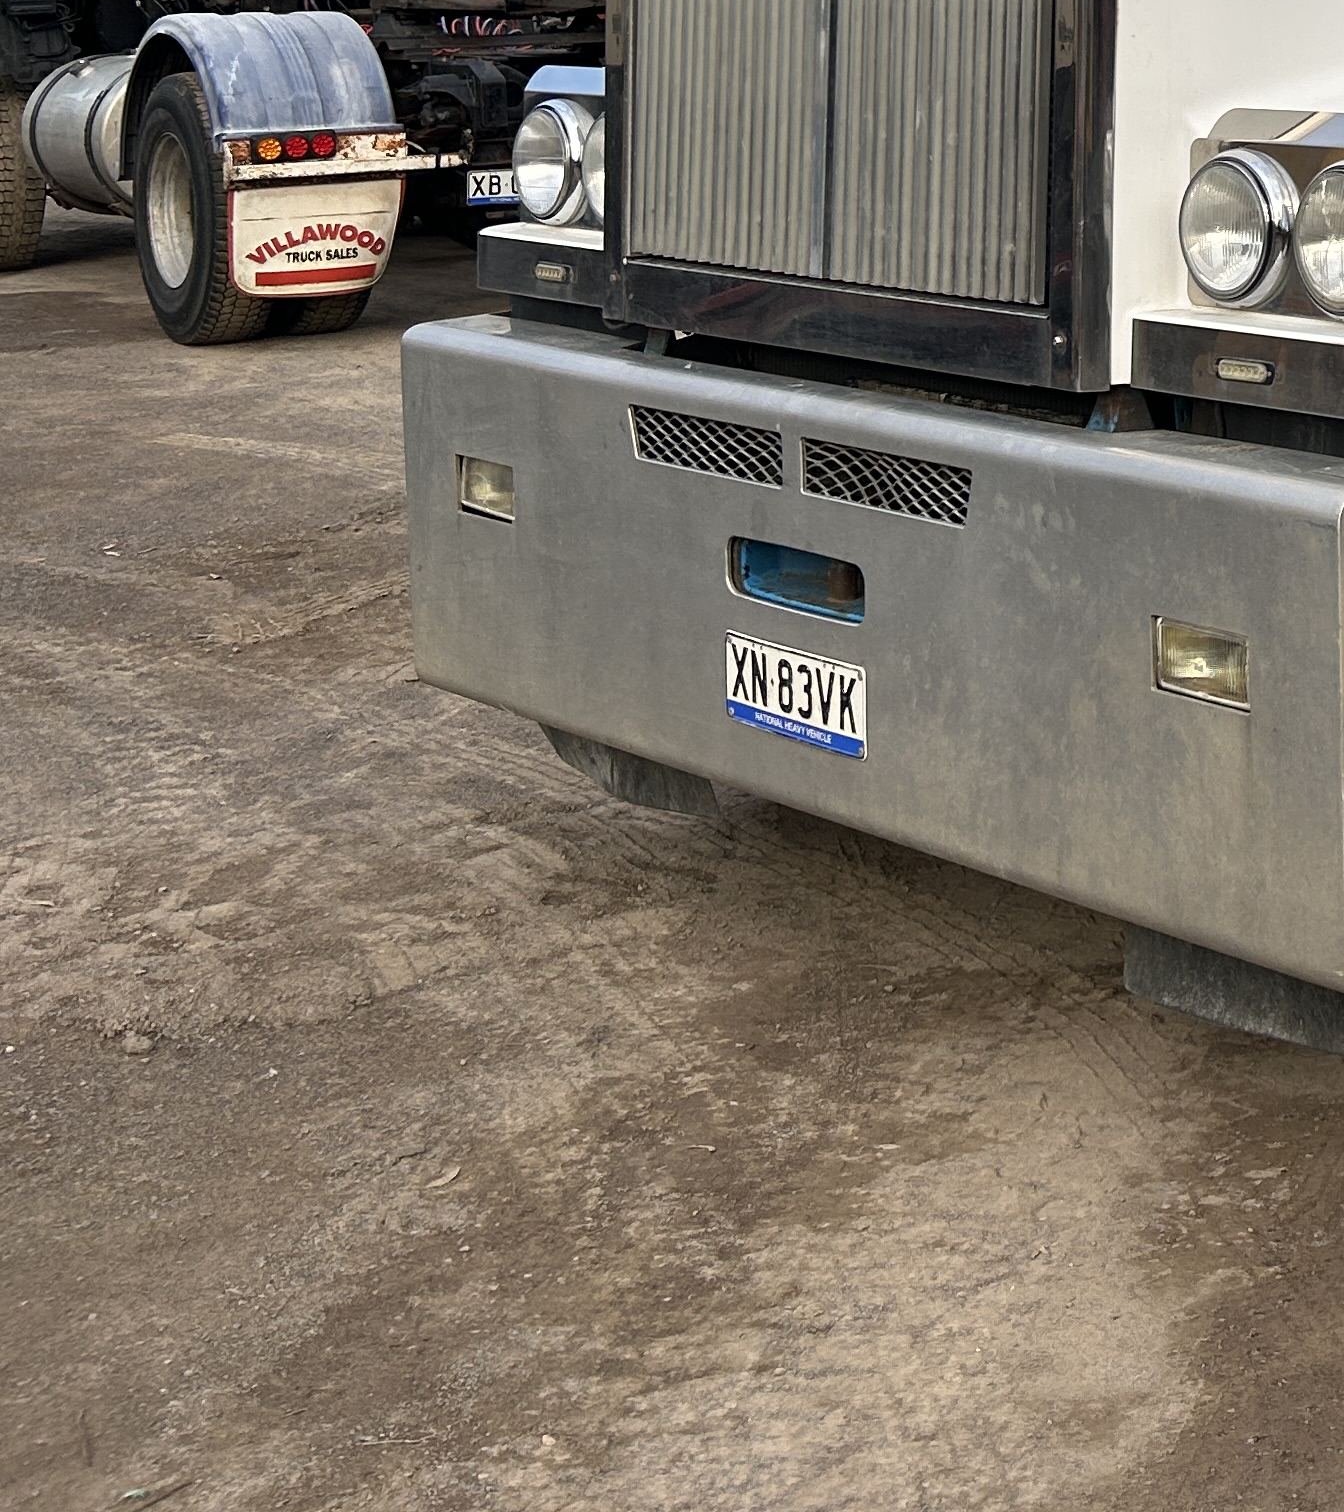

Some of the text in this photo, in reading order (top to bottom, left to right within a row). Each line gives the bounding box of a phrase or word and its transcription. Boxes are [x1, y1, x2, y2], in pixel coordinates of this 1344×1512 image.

[245, 223, 386, 265] VILLAWOOD
[285, 247, 359, 263] TRUCK SALES
[754, 712, 832, 745] NATIONAL HEAVY VEHICLE
